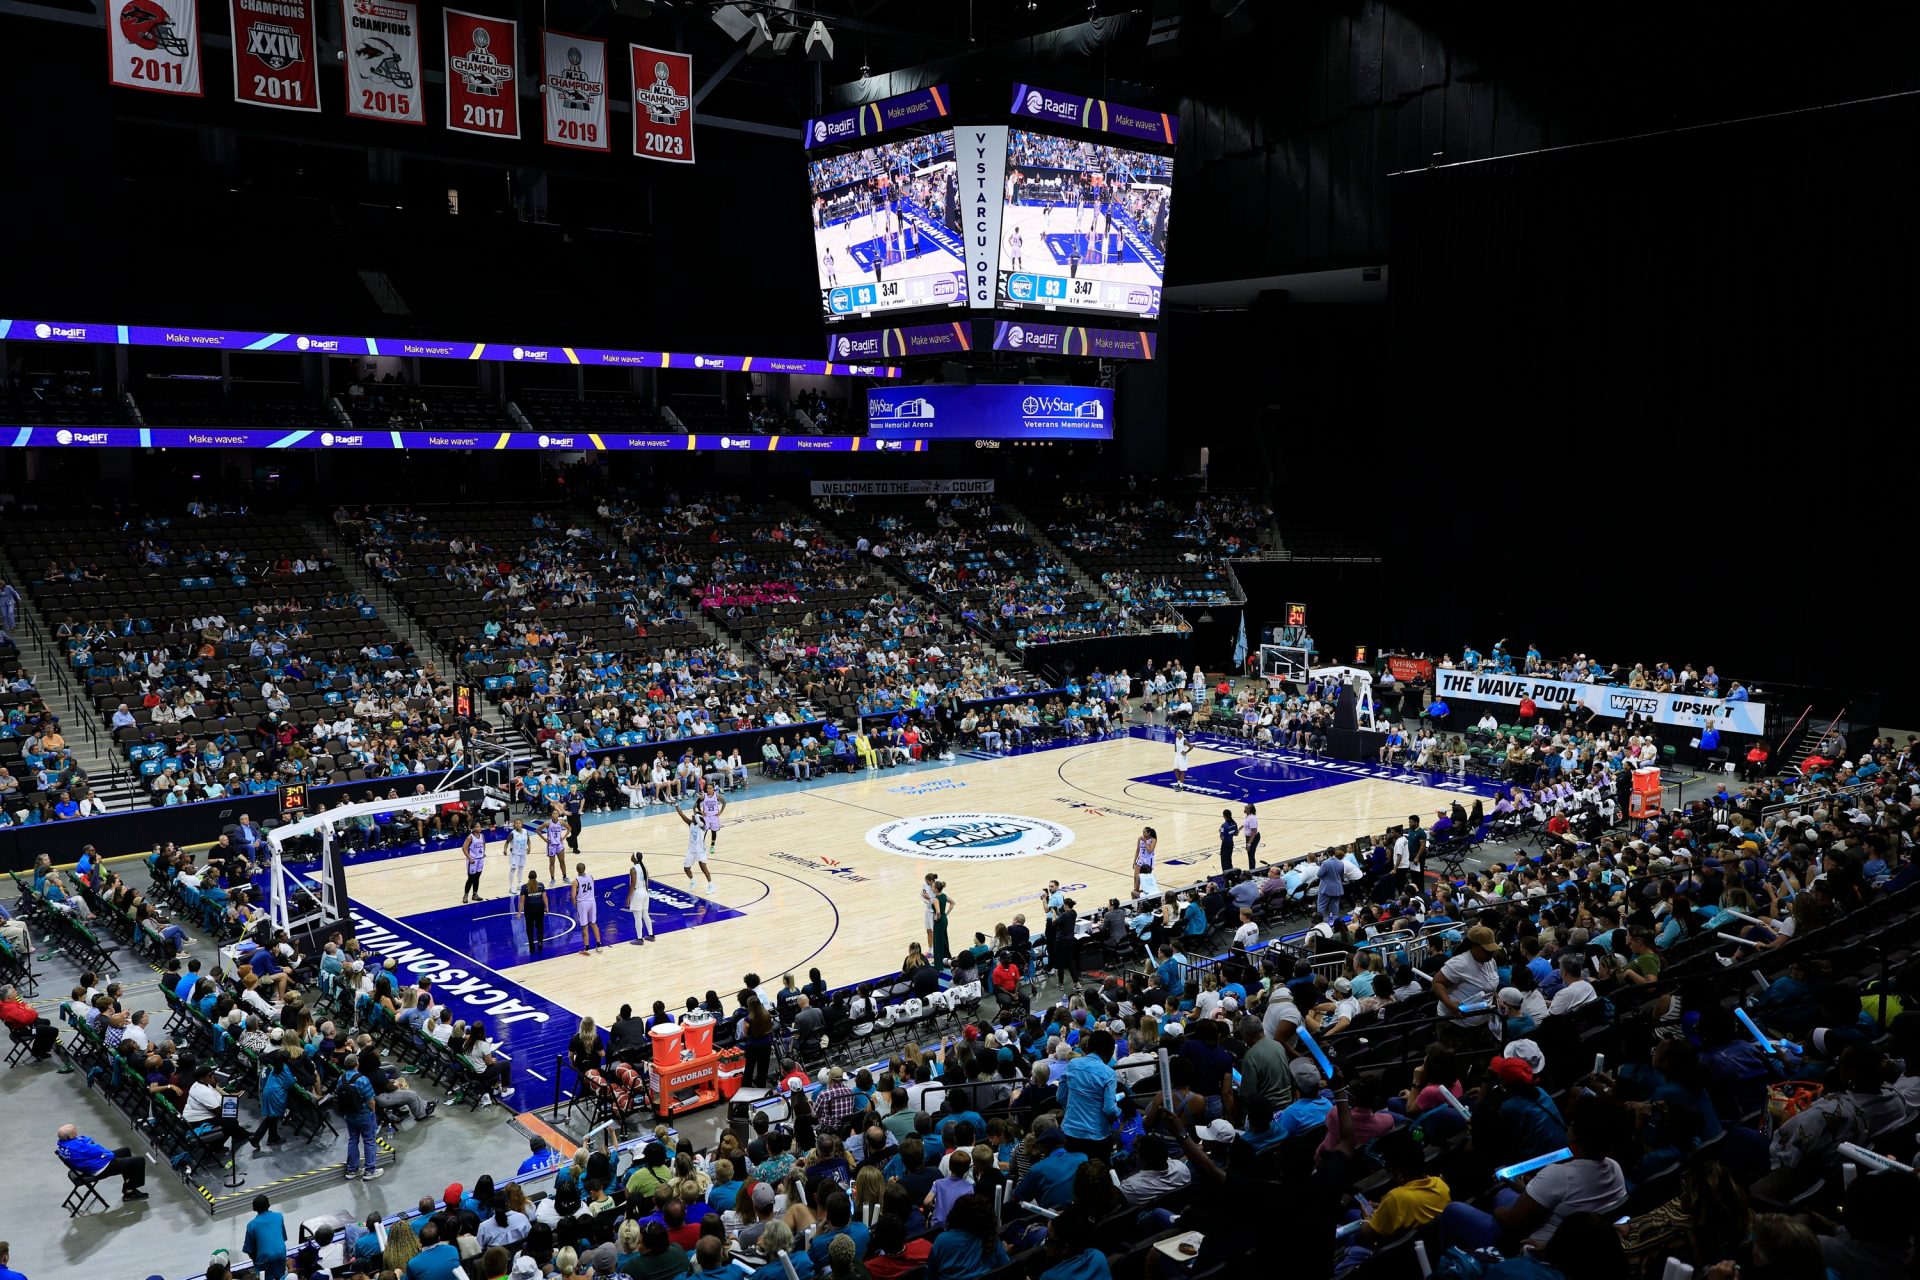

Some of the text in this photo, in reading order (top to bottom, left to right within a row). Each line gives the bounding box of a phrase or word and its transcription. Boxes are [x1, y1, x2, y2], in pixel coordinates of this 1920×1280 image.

[240, 0, 306, 20] CHAMPIONS
[256, 23, 292, 36] ARENABOWL
[352, 15, 411, 37] CHAMPIONS
[249, 30, 301, 60] XXIV
[130, 56, 183, 85] 2011
[455, 60, 510, 78] CHAMPIONS
[254, 74, 302, 102] 2011
[550, 77, 601, 94] CHAMPIONS
[362, 89, 410, 115] 2015
[639, 91, 686, 108] CHAMPIONS
[887, 107, 905, 119] Make
[1044, 98, 1078, 116] RadiFi
[463, 104, 504, 129] 2017
[1115, 114, 1134, 127] Make
[557, 119, 598, 143] 2019
[827, 118, 855, 135] RadiFi
[645, 132, 684, 156] 2023
[882, 282, 898, 296] 3:47
[957, 274, 967, 297] CLT
[1000, 271, 1009, 298] JAX
[1045, 280, 1060, 296] 93
[1074, 280, 1092, 295] 3:47
[858, 287, 871, 303] 93
[52, 327, 87, 338] RadiFi
[166, 334, 190, 343] Make
[1026, 332, 1059, 345] RadiFi
[310, 339, 338, 350] RadiFi
[852, 339, 878, 352] RadiFi
[911, 336, 928, 346] Make
[1095, 338, 1114, 348] Make
[404, 344, 424, 353] Make
[524, 350, 548, 359] RadiFi
[603, 354, 619, 362] Make
[704, 357, 724, 367] RadiFi
[770, 362, 786, 370] Make
[1038, 396, 1074, 416] VyStar
[912, 421, 934, 429] Arena
[1024, 421, 1059, 429] Veterans
[1060, 421, 1090, 429] Memorial
[74, 433, 108, 443] RadiFi
[189, 435, 213, 444] Make
[335, 435, 363, 445] RadiFi
[429, 437, 449, 446] Make
[550, 438, 575, 446] RadiFi
[628, 439, 645, 447] Make
[730, 440, 751, 448] RadiFi
[982, 440, 1000, 449] VyStar
[822, 482, 874, 494] WELCOME
[875, 482, 888, 493] TO
[890, 481, 909, 493] THE
[952, 481, 988, 493] COURT
[1289, 613, 1304, 625] 24
[1443, 675, 1577, 705] THE WAVE POOL
[457, 697, 470, 717] 24
[1610, 694, 1658, 714] WAVES
[1671, 700, 1735, 718] UPSHOT
[286, 786, 304, 797] 3:47
[411, 792, 451, 802] JACKSONVILLE
[286, 796, 301, 808] 24
[917, 823, 1033, 850] WAVES
[957, 852, 1016, 860] WELCOME
[581, 882, 593, 894] 24
[670, 1067, 714, 1086] GATORADE
